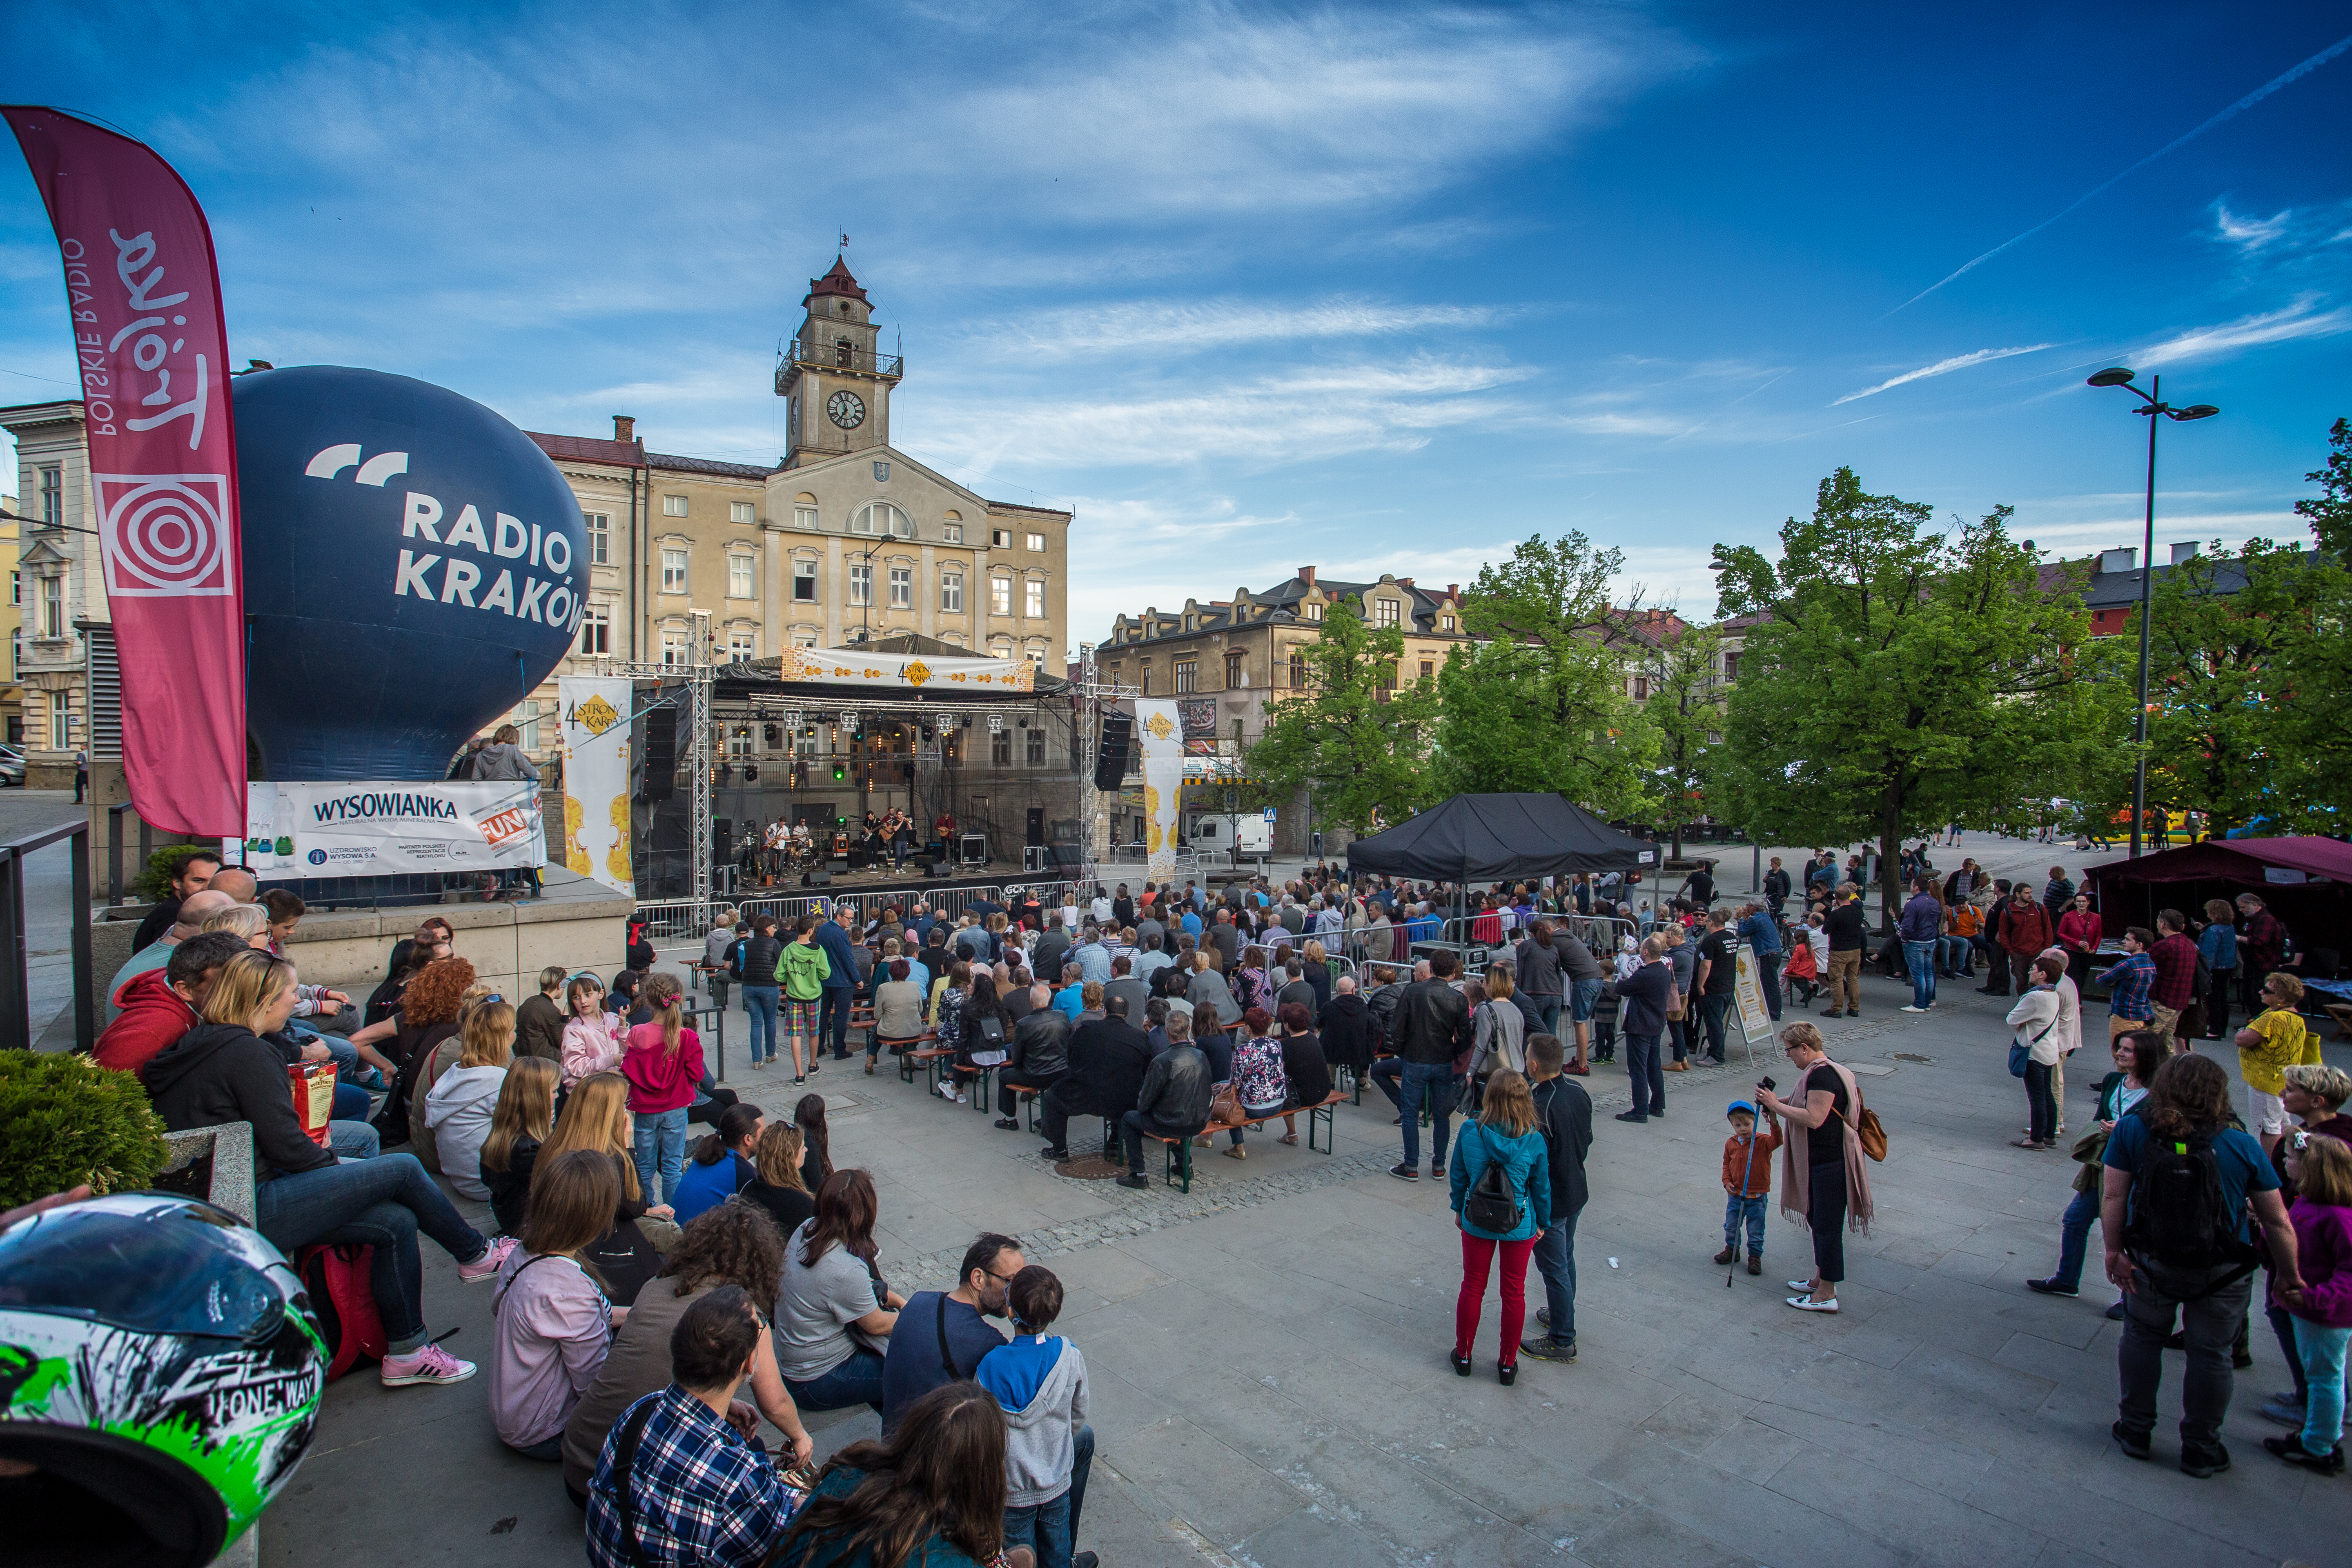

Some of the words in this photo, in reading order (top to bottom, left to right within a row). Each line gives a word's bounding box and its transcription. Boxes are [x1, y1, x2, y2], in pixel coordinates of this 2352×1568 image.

[402, 491, 572, 575] RADIO
[898, 661, 907, 684] 4
[906, 664, 935, 675] STRONY
[910, 673, 936, 683] KARPAT
[565, 697, 580, 730] 4
[578, 703, 623, 716] STRONY
[586, 715, 626, 728] KARPAT
[1142, 714, 1151, 737] 4
[1148, 717, 1175, 727] STRONY
[1154, 726, 1179, 736] KARPAT
[314, 793, 459, 822] WYSOWIANKA
[339, 817, 377, 826] NATURALNA
[479, 809, 525, 843] FUN
[1005, 885, 1026, 894] GCK
